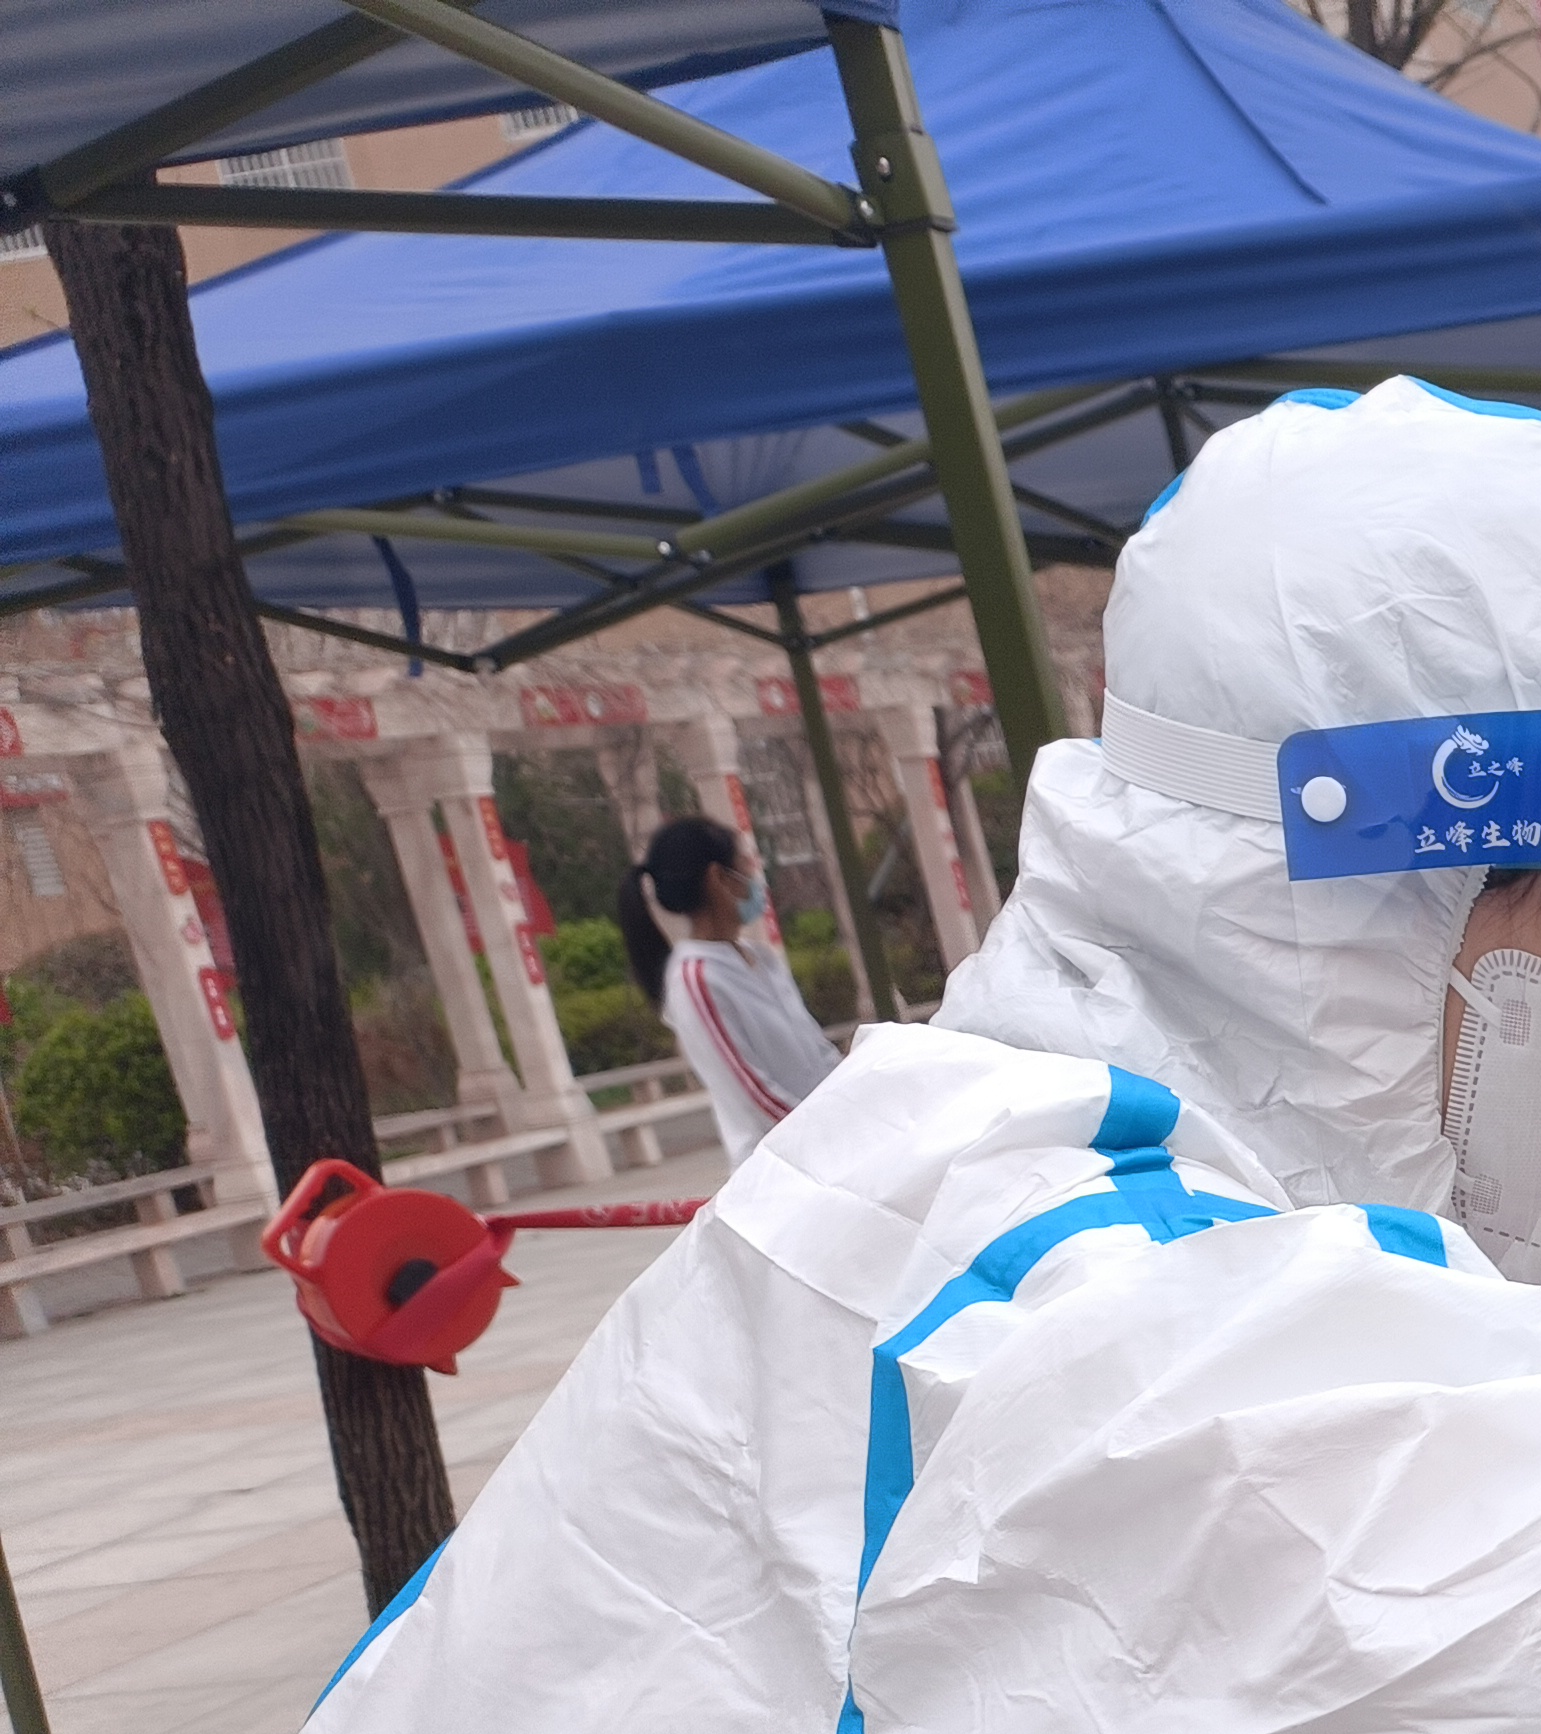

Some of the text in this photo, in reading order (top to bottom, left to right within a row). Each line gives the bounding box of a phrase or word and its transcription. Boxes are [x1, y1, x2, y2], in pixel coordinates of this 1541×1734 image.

[1467, 756, 1524, 778] 立之峰
[1414, 819, 1541, 853] 立峰生物
